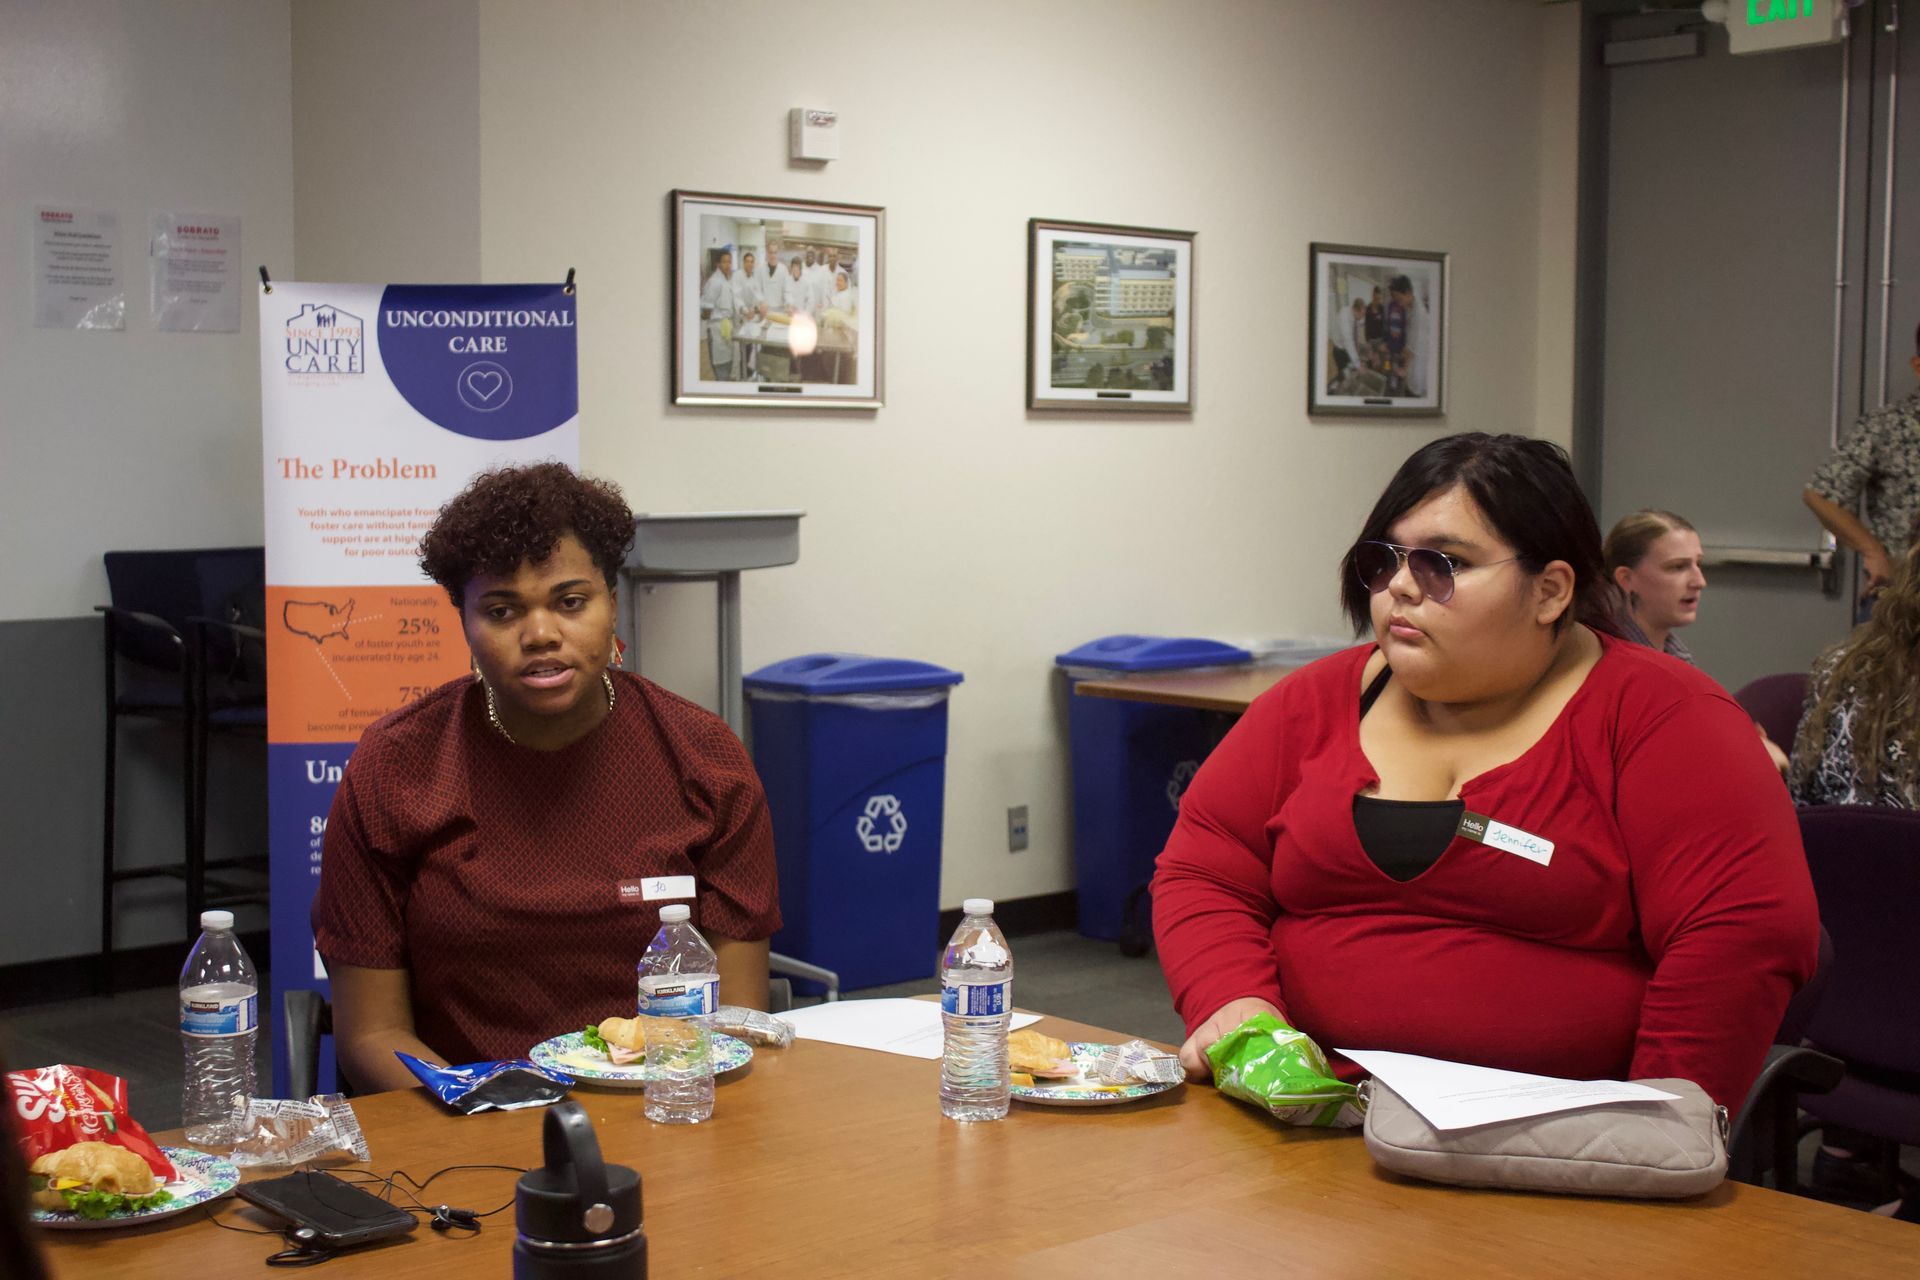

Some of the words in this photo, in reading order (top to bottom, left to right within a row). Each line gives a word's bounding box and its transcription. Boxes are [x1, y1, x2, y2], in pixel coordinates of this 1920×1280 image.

[386, 310, 574, 327] UNCONDITIONAL
[330, 327, 361, 338] 1993
[286, 338, 360, 355] UNITY
[449, 336, 508, 353] CARE
[285, 355, 359, 372] CARE
[277, 457, 323, 480] The
[332, 457, 437, 480] Problem
[298, 508, 327, 517] Youth
[330, 508, 351, 517] who
[354, 508, 412, 518] emancipate
[310, 521, 340, 530] foster
[366, 521, 405, 530] without
[407, 521, 435, 530] famil
[321, 534, 361, 544] support
[382, 535, 392, 543] at
[394, 534, 417, 544] high
[344, 547, 359, 556] for
[362, 549, 385, 558] poor
[398, 618, 440, 635] 25%
[355, 639, 364, 648] of
[367, 639, 394, 648] foster
[397, 639, 424, 649] youth
[332, 653, 391, 663] incarcerated
[393, 653, 405, 664] by
[407, 655, 425, 663] age
[338, 708, 348, 717] of
[308, 723, 347, 732] become
[1463, 818, 1485, 832] Hello
[1493, 830, 1547, 854] Jennifer
[620, 885, 640, 894] Hello
[657, 987, 686, 995] KIRKLAND
